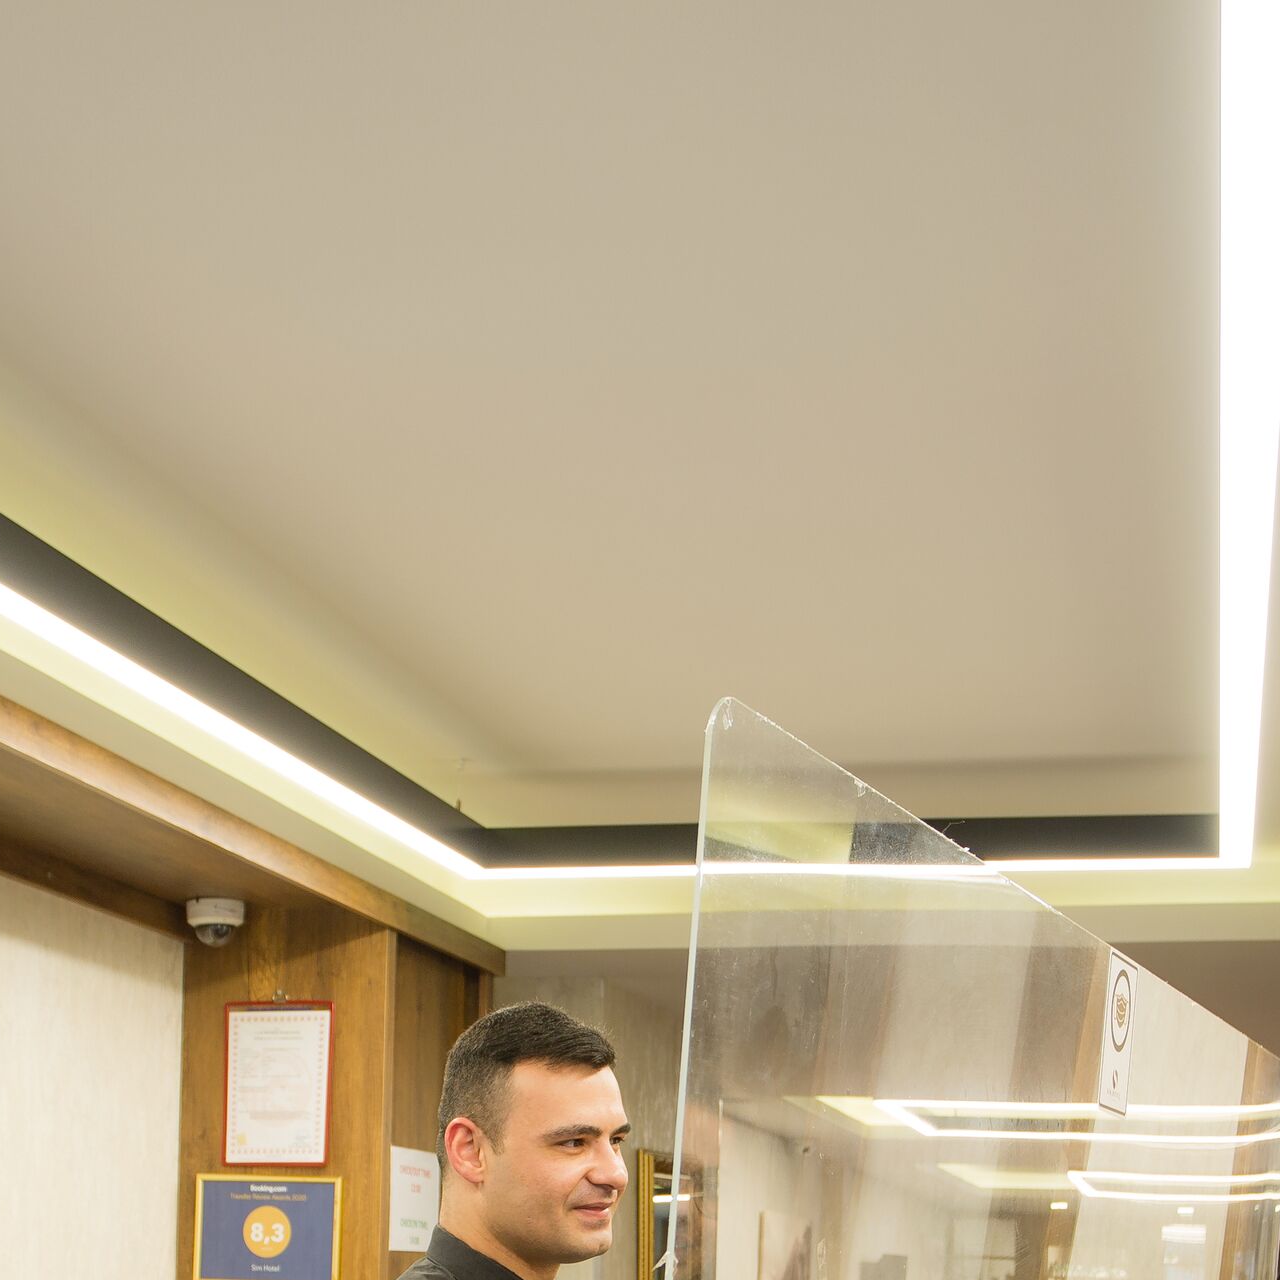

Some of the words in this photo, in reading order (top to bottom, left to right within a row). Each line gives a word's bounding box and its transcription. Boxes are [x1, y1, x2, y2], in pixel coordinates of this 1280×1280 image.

[250, 1184, 287, 1193] Booking.com
[250, 1222, 284, 1245] 8,3
[264, 1264, 280, 1273] Hotel
